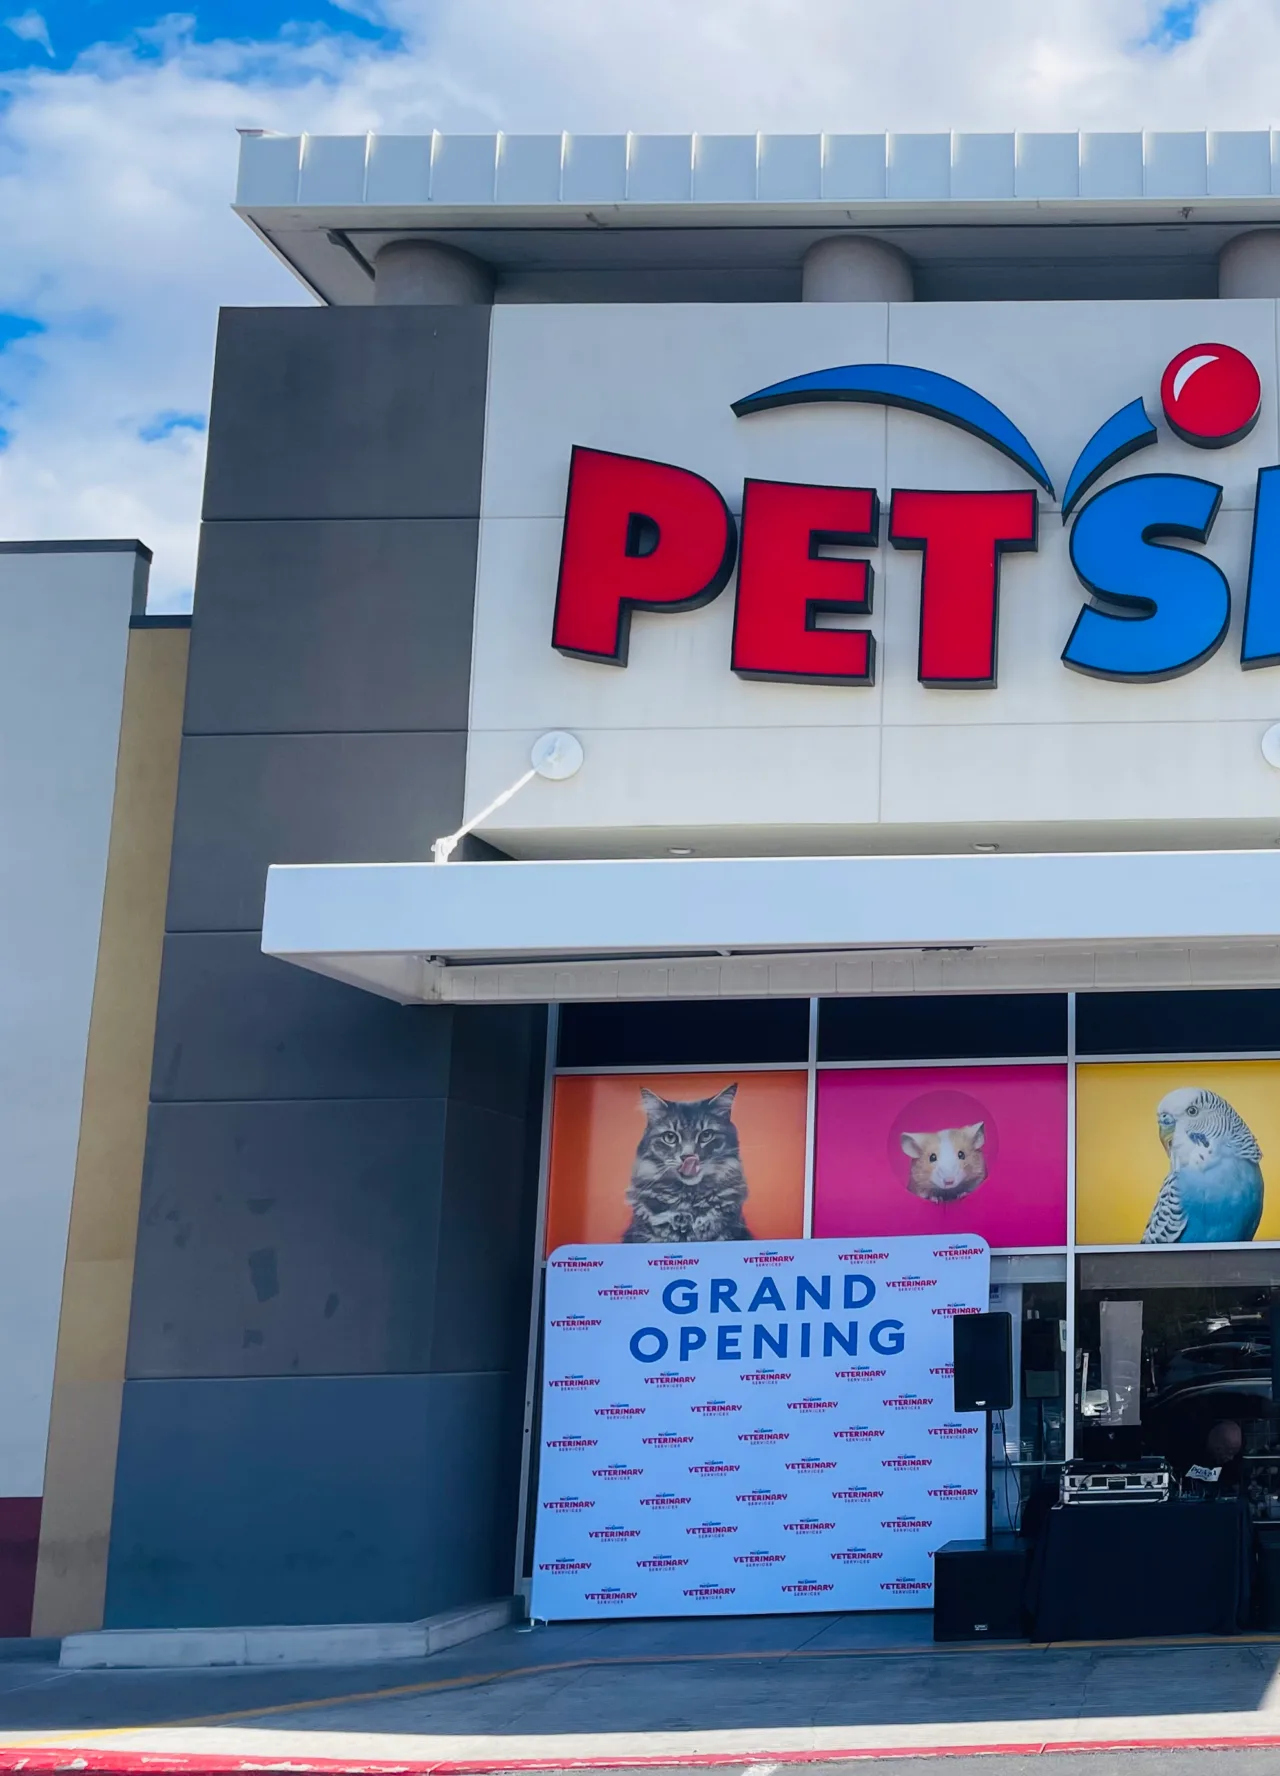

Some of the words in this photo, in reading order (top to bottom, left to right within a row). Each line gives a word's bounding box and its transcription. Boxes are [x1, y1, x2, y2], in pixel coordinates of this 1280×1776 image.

[933, 1248, 984, 1257] VETERINARY
[744, 1255, 795, 1263] VETERINARY
[838, 1253, 890, 1261] VETERINARY
[886, 1280, 938, 1288] VETERINARY
[662, 1274, 876, 1315] GRAND
[551, 1319, 602, 1327] VETERINARY
[629, 1319, 906, 1364] OPENING
[740, 1373, 792, 1381] VETERINARY
[835, 1370, 886, 1378] VETERINARY
[549, 1379, 601, 1387] VETERINARY
[645, 1376, 696, 1384] VETERINARY
[788, 1401, 839, 1409] VETERINARY
[883, 1398, 934, 1406] VETERINARY
[738, 1433, 790, 1441] VETERINARY
[834, 1430, 885, 1438] VETERINARY
[642, 1436, 694, 1444] VETERINARY
[786, 1462, 837, 1470] VETERINARY
[882, 1459, 933, 1467] VETERINARY
[689, 1465, 740, 1473] VETERINARY
[736, 1494, 787, 1502] VETERINARY
[832, 1491, 884, 1499] VETERINARY
[544, 1501, 594, 1509] VETERINARY
[640, 1497, 691, 1505] VETERINARY
[881, 1520, 932, 1528] VETERINARY
[590, 1530, 641, 1538] VETERINARY
[686, 1526, 738, 1534] VETERINARY
[734, 1555, 785, 1563] VETERINARY
[832, 1552, 883, 1560] VETERINARY
[638, 1559, 688, 1567] VETERINARY
[782, 1584, 833, 1592] VETERINARY
[881, 1582, 932, 1590] VETERINARY
[586, 1592, 637, 1600] VETERINARY
[684, 1588, 735, 1596] VETERINARY
